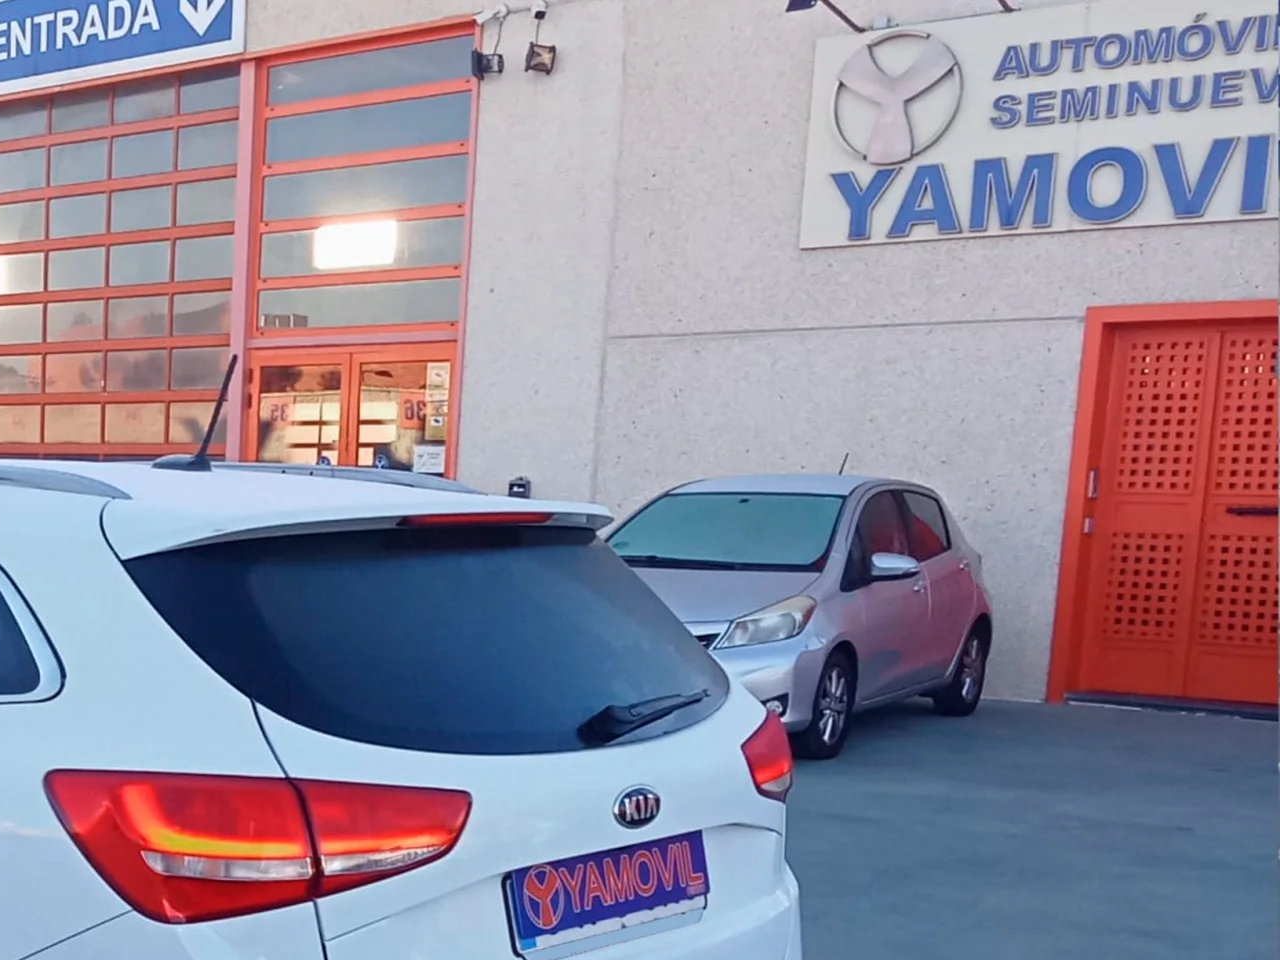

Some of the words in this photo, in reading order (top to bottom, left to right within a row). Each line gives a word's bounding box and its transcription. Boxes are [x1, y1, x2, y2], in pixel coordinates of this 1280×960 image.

[992, 12, 1278, 81] AUTOMÓVI
[623, 793, 658, 822] KIA
[559, 840, 705, 914] YAMOVIL
